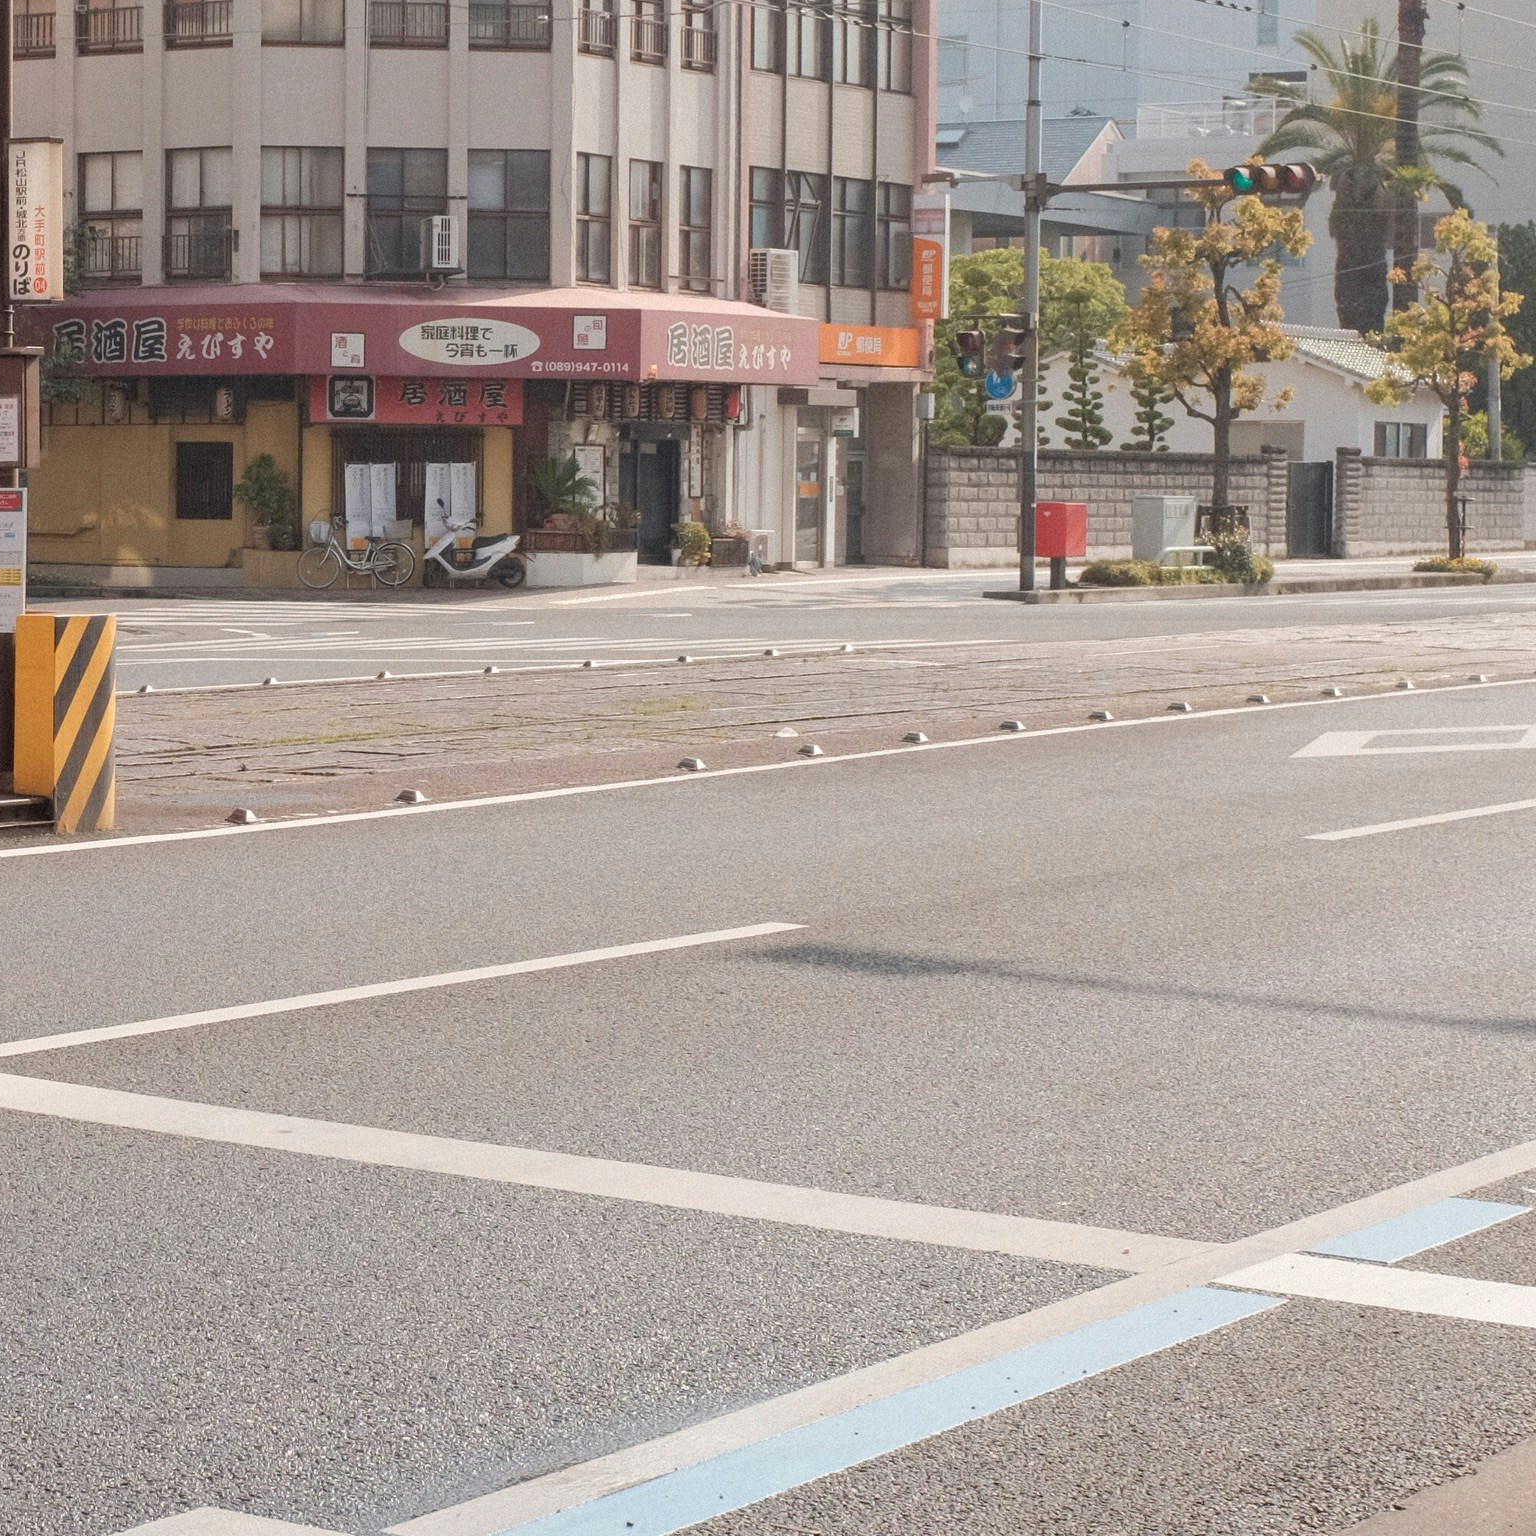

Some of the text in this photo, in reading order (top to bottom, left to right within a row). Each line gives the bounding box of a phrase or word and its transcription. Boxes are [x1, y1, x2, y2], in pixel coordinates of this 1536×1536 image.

[34, 205, 46, 292] 大手町駅前 04
[13, 243, 32, 295] のりば
[52, 317, 275, 363] 居酒屋 えびすや
[420, 324, 493, 341] 家庭料理で
[667, 322, 734, 370] 居酒屋
[739, 343, 792, 371] えびすや
[855, 336, 882, 355] 郵便局
[445, 343, 519, 359] 今宵も一杯
[544, 360, 630, 373] (089)947-0114
[398, 381, 509, 409] 居酒屋
